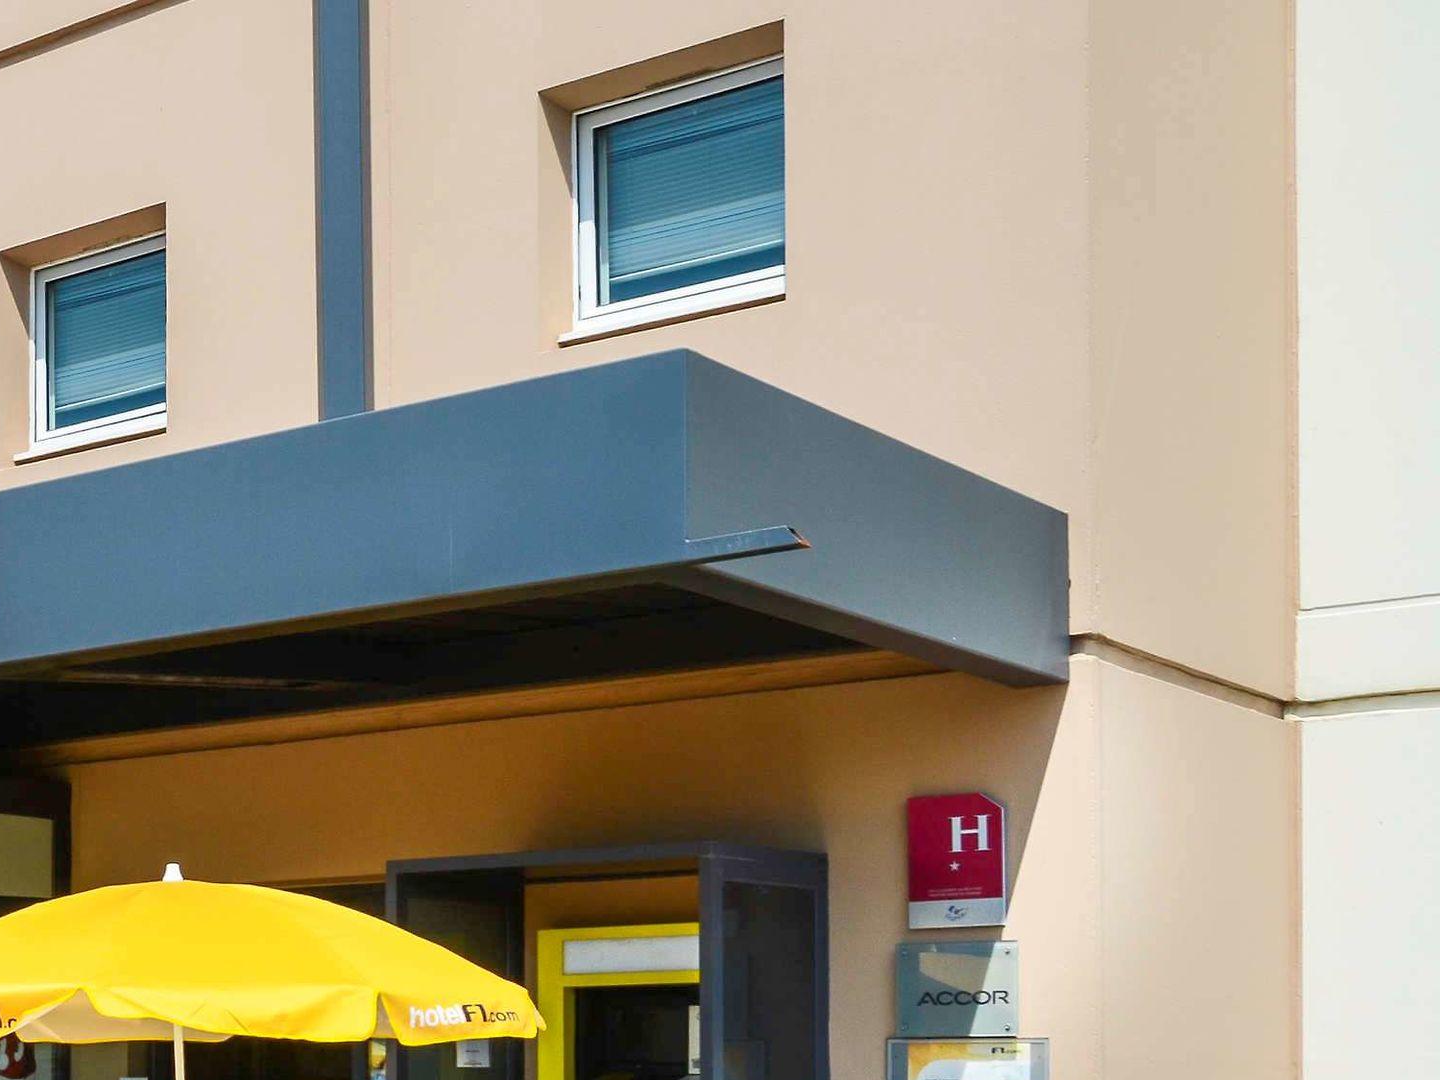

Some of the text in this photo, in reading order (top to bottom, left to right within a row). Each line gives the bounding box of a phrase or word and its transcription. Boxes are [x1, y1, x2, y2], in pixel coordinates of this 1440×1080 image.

[948, 814, 992, 853] H
[917, 990, 1010, 1007] ACCOR
[410, 1003, 520, 1028] hotelF1.com
